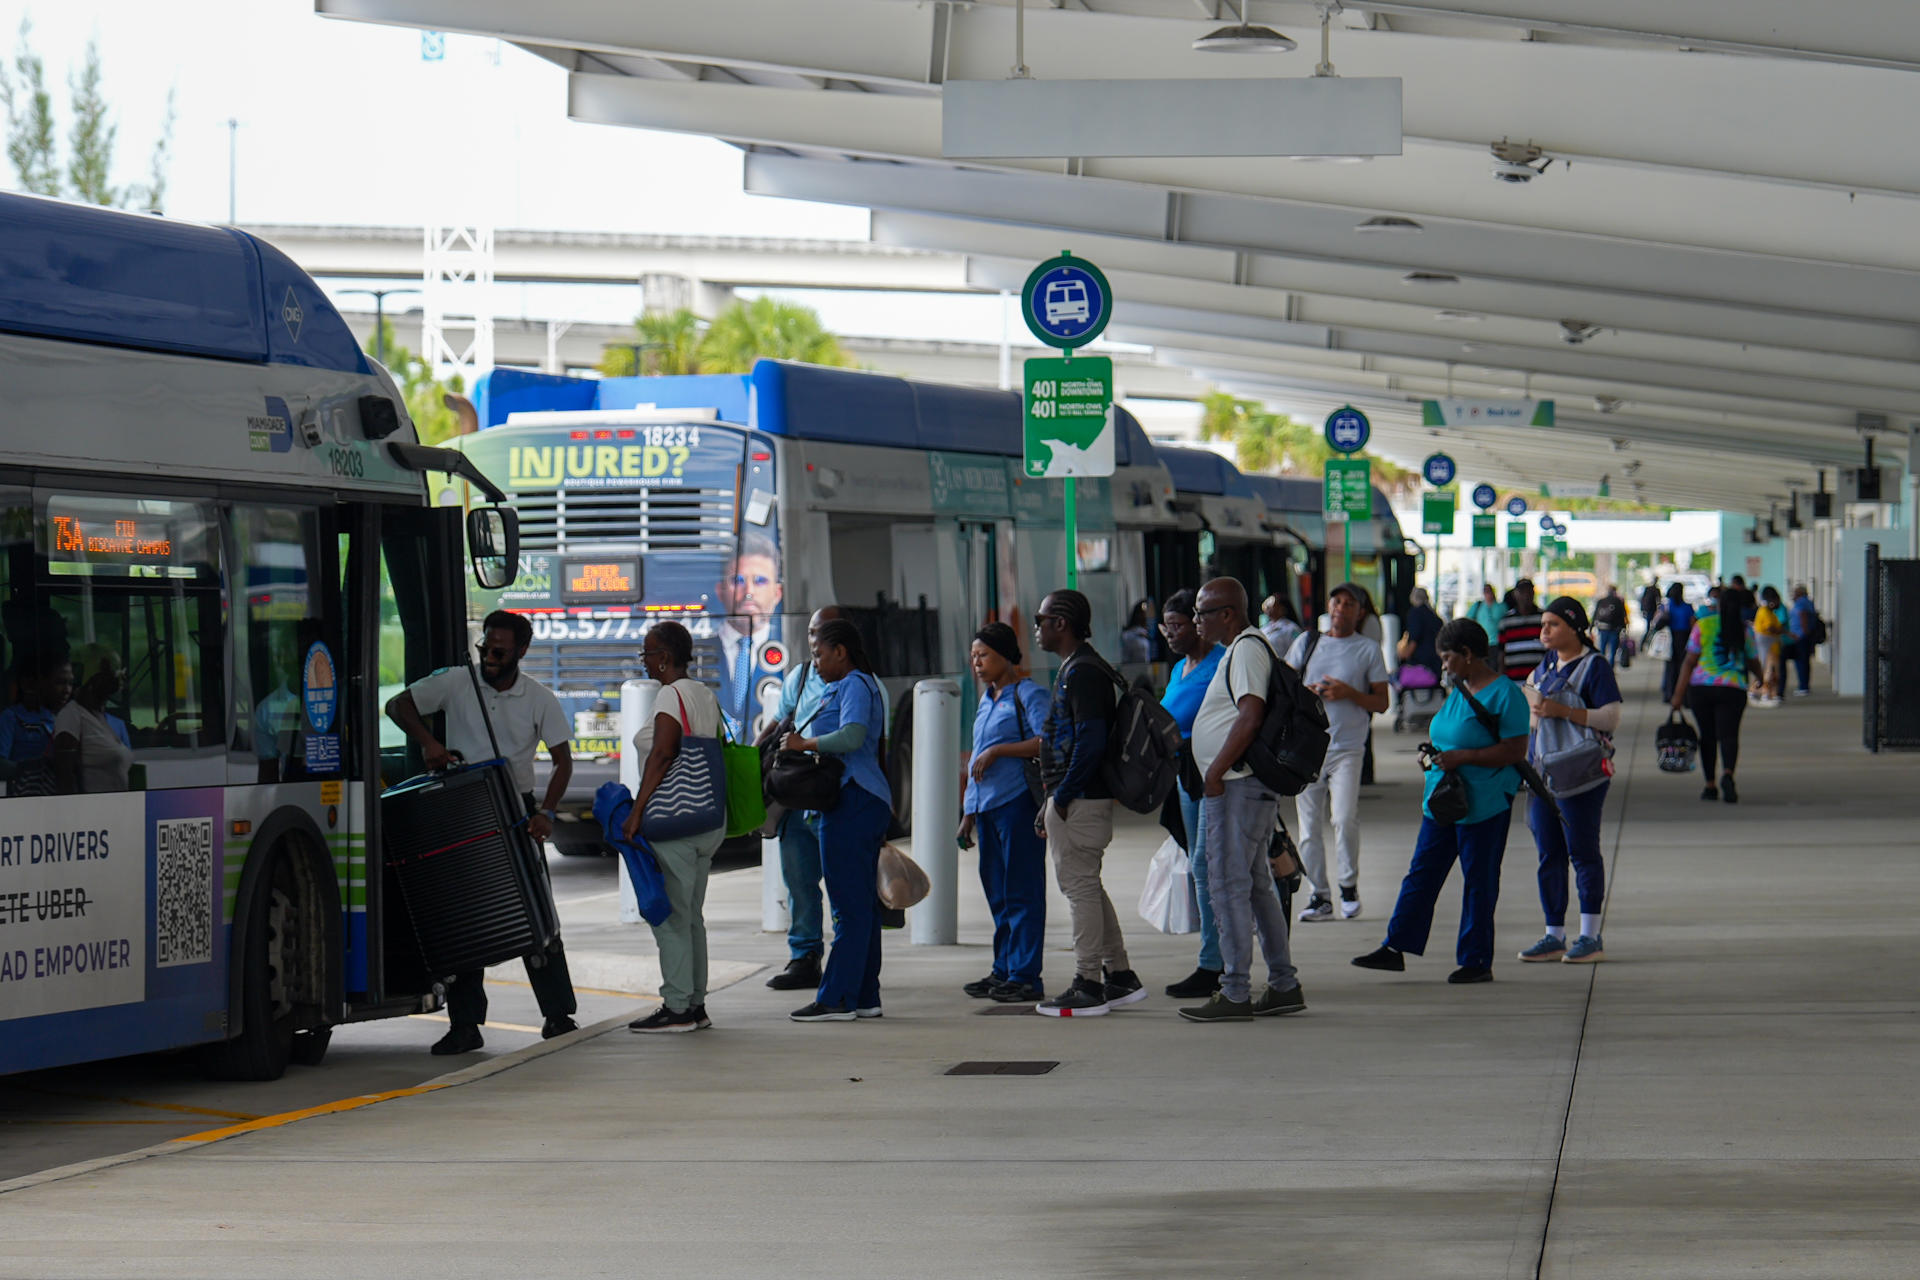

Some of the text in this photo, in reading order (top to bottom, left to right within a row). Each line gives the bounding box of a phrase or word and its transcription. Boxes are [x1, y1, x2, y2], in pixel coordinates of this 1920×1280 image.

[1031, 380, 1057, 398] 401
[1061, 388, 1104, 397] DOWNTOWN
[1031, 400, 1057, 418] 401
[642, 426, 700, 448] 18234
[328, 448, 364, 478] 18203
[508, 445, 690, 487] INJURED?
[53, 516, 137, 551] 75A FIU
[88, 536, 171, 556] BISCAYNE CAMPUS
[583, 565, 619, 578] ENTER
[572, 577, 630, 592] NEW CODE
[1, 830, 110, 867] RT DRIVERS
[37, 887, 86, 921] UBER
[0, 939, 131, 982] AD EMPOWER
